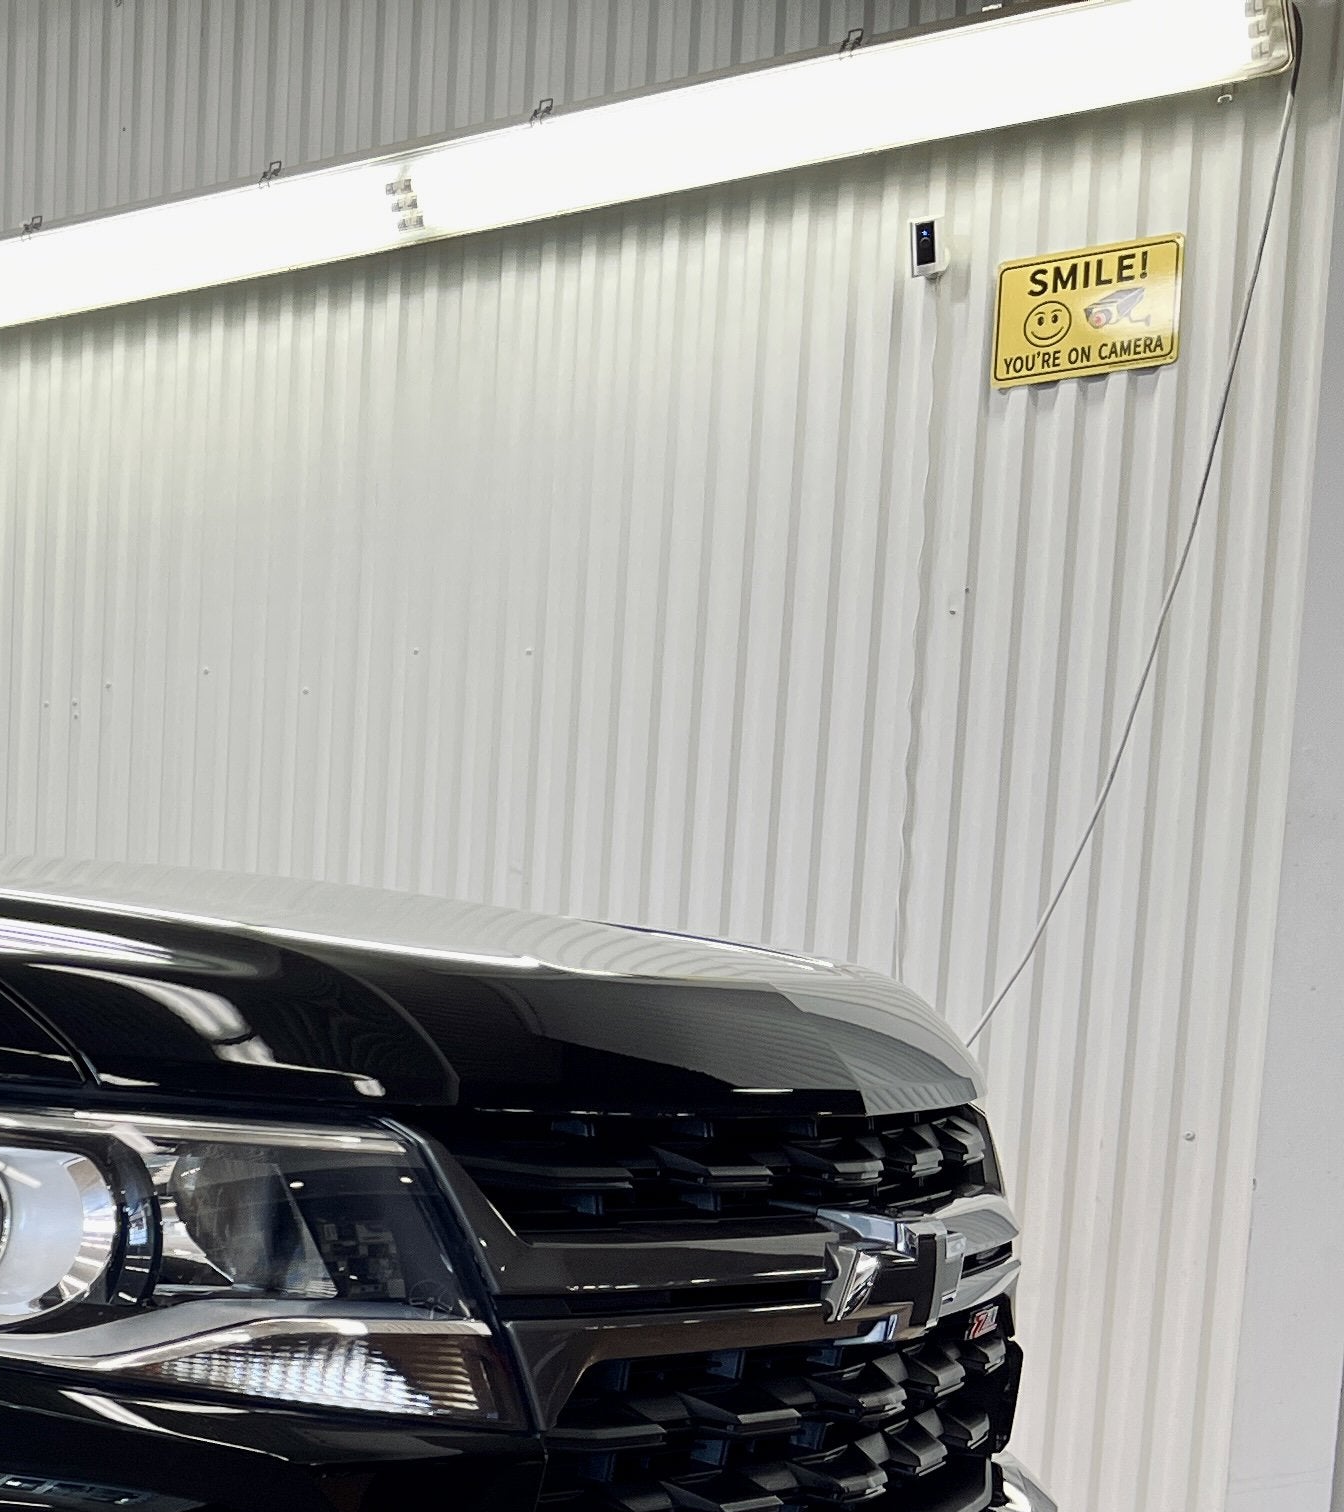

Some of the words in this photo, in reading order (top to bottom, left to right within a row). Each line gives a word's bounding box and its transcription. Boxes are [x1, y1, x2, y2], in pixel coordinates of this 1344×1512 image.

[1027, 250, 1148, 297] SMILE!
[1003, 350, 1061, 375] YOU'RE
[1067, 345, 1092, 365] ON
[1098, 335, 1164, 360] CAMERA
